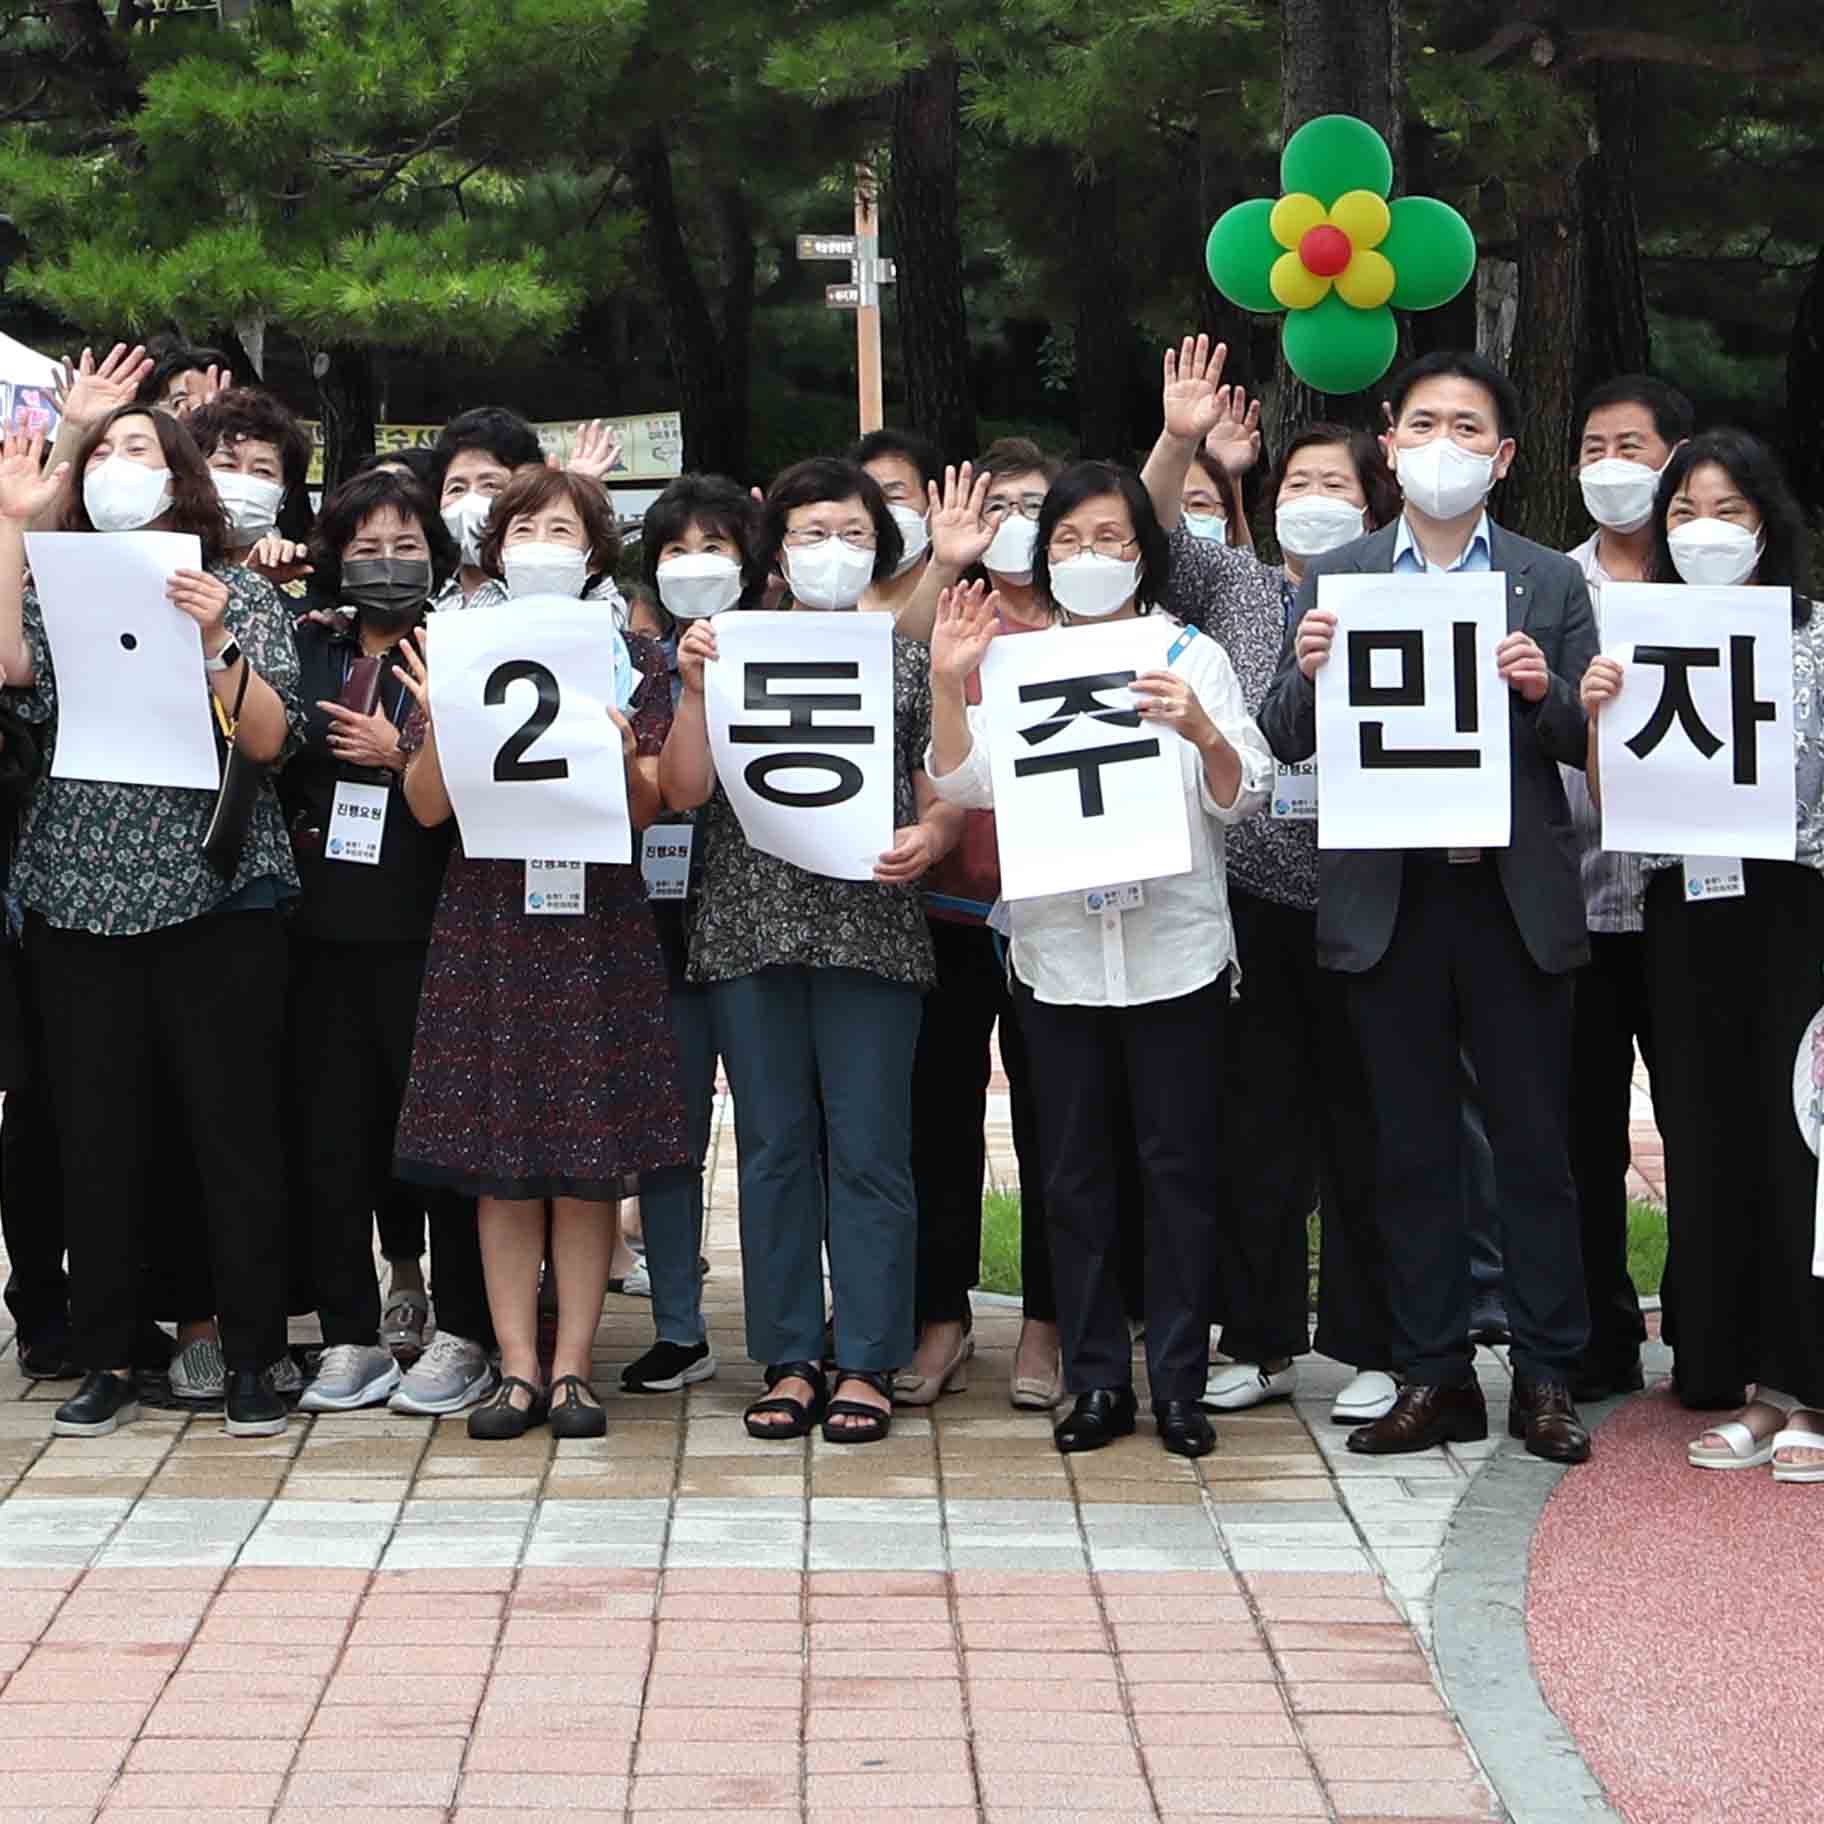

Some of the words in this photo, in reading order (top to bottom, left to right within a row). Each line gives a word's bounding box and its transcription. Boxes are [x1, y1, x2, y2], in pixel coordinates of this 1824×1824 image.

[483, 660, 569, 782] 2
[729, 661, 875, 808] 동
[1014, 670, 1160, 817] 주
[1347, 621, 1481, 769] 민
[1624, 635, 1776, 785] 자
